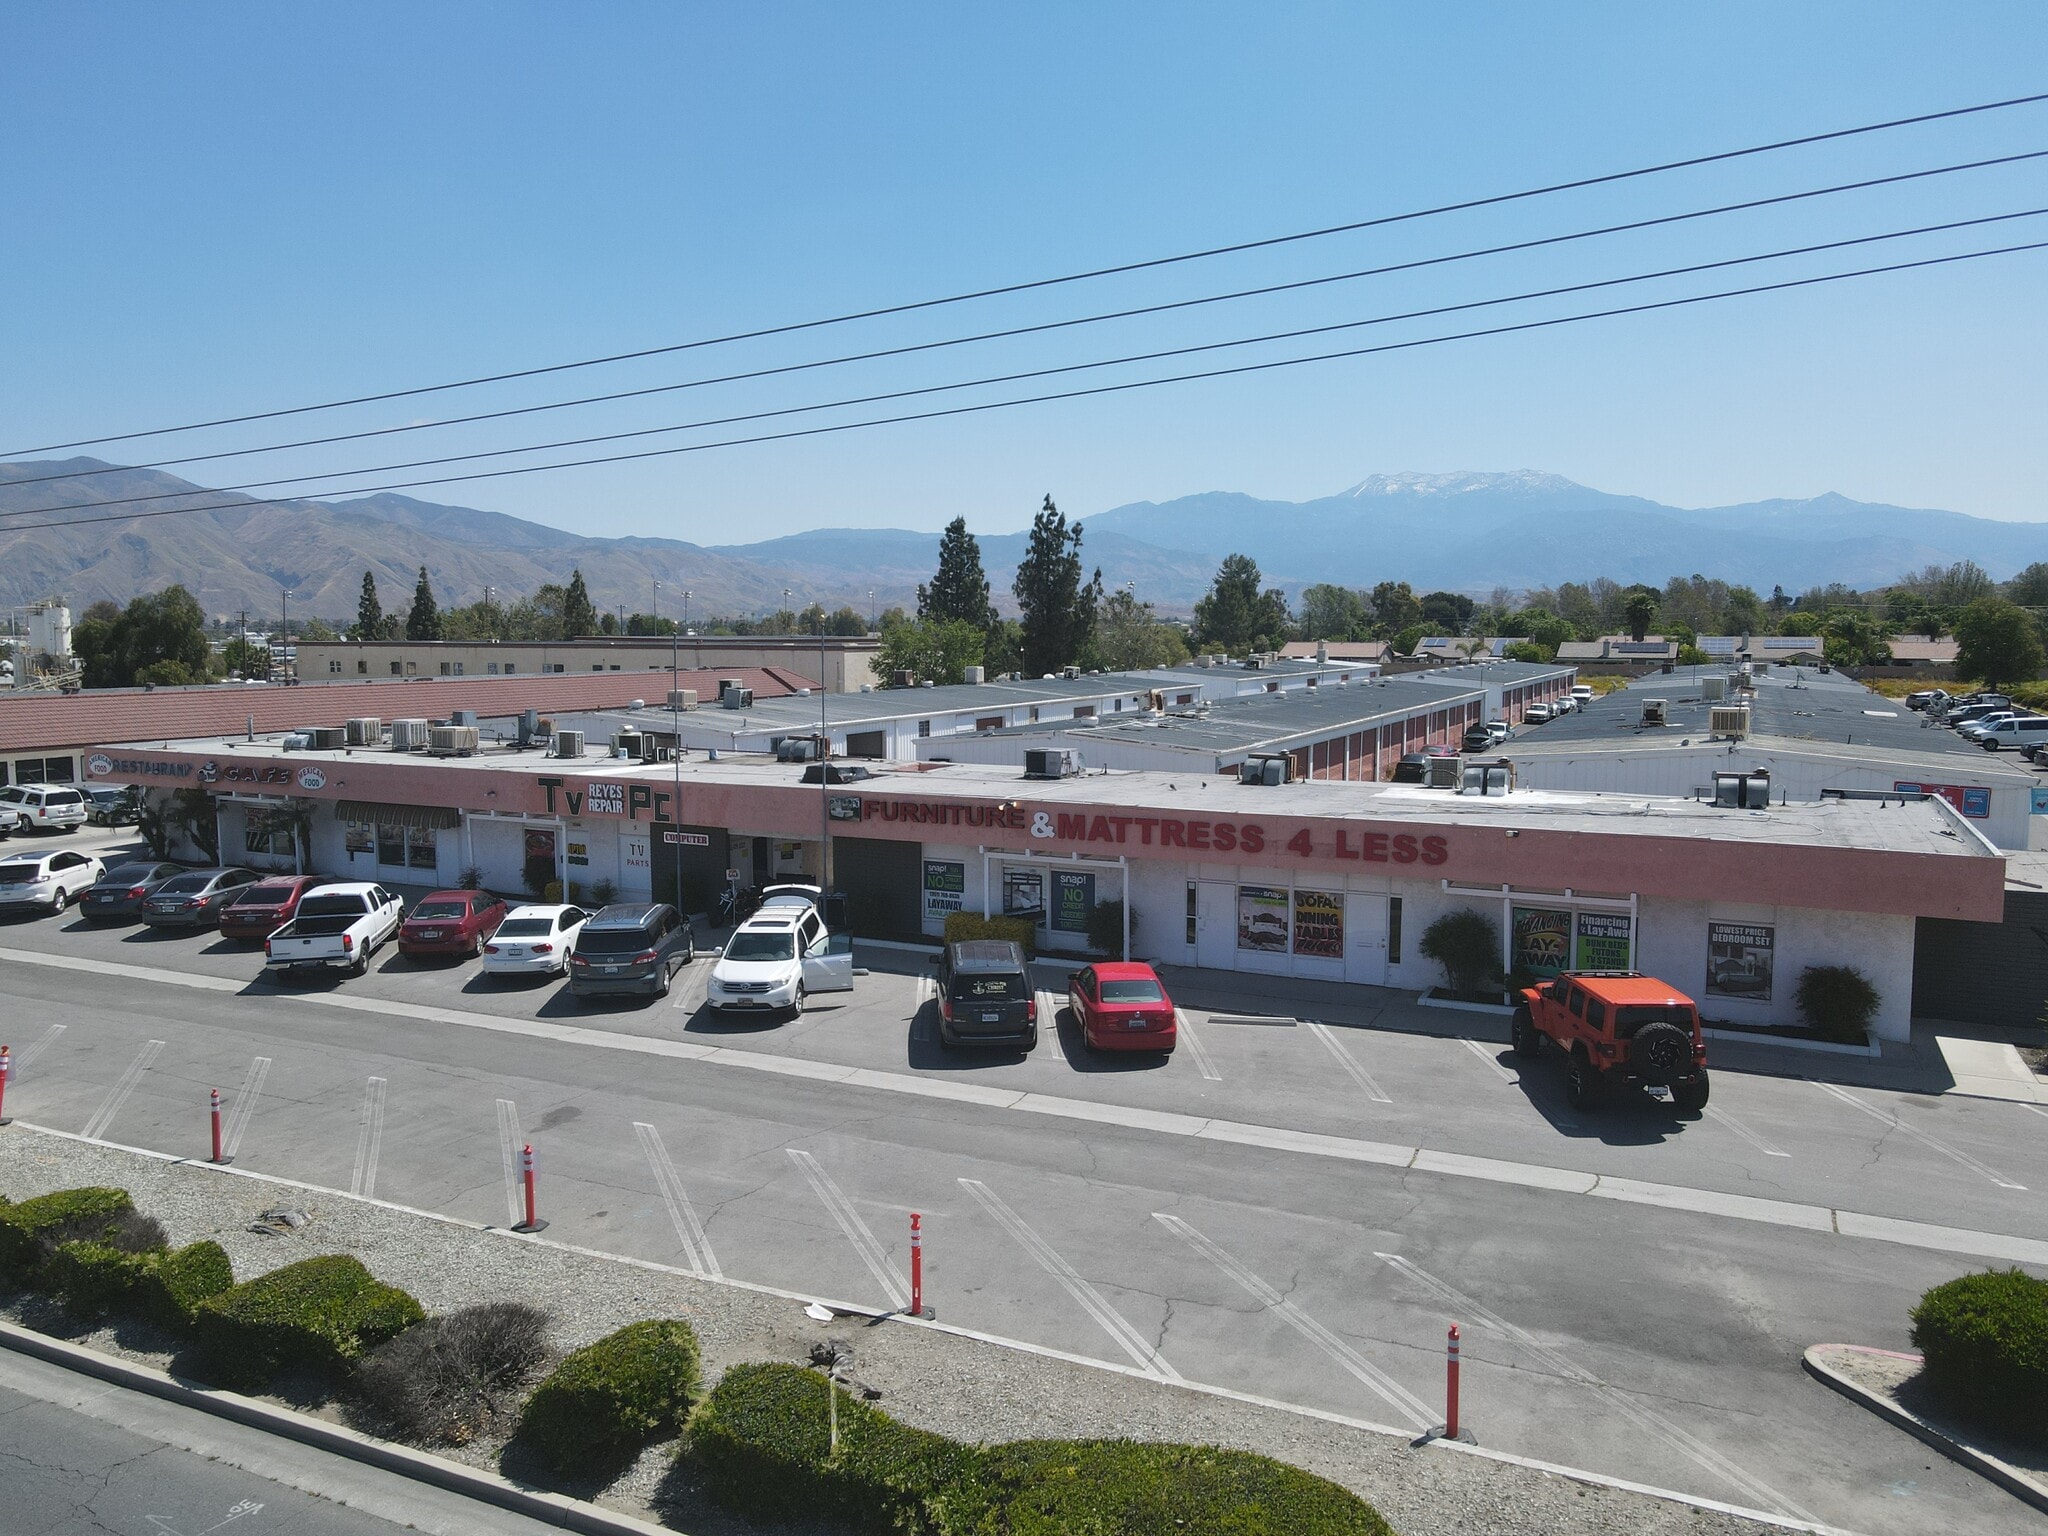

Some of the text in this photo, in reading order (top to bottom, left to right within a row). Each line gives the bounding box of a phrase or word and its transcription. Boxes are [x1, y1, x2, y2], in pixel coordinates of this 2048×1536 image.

[88, 754, 112, 767] AMERICAN
[94, 764, 107, 773] FOOD
[223, 766, 293, 784] CAFE
[298, 766, 326, 780] MEXICAN
[304, 778, 320, 787] FOOD
[588, 783, 623, 798] REYES
[588, 799, 624, 814] REPAIR
[665, 832, 708, 845] COMPUTER
[863, 800, 1448, 865] FURNITURE & MATTRESS 4 LESS
[630, 843, 644, 856] TV
[626, 859, 649, 867] PARTS
[927, 864, 947, 874] snap!
[927, 875, 945, 888] NO
[1060, 875, 1087, 886] snap!
[1064, 888, 1084, 902] NO
[927, 898, 963, 911] LAYAWAY
[1062, 901, 1085, 910] CREDIT
[1296, 911, 1339, 926] DINING
[1580, 914, 1629, 929] Financing
[1587, 925, 1630, 938] Lay-Awa
[1715, 925, 1767, 937] LOWEST PRICE
[1585, 938, 1628, 950] BUNK BEDS
[1712, 933, 1771, 946] BEDROOM SET
[1592, 948, 1621, 957] FUTONS
[1597, 956, 1626, 966] STANDS
